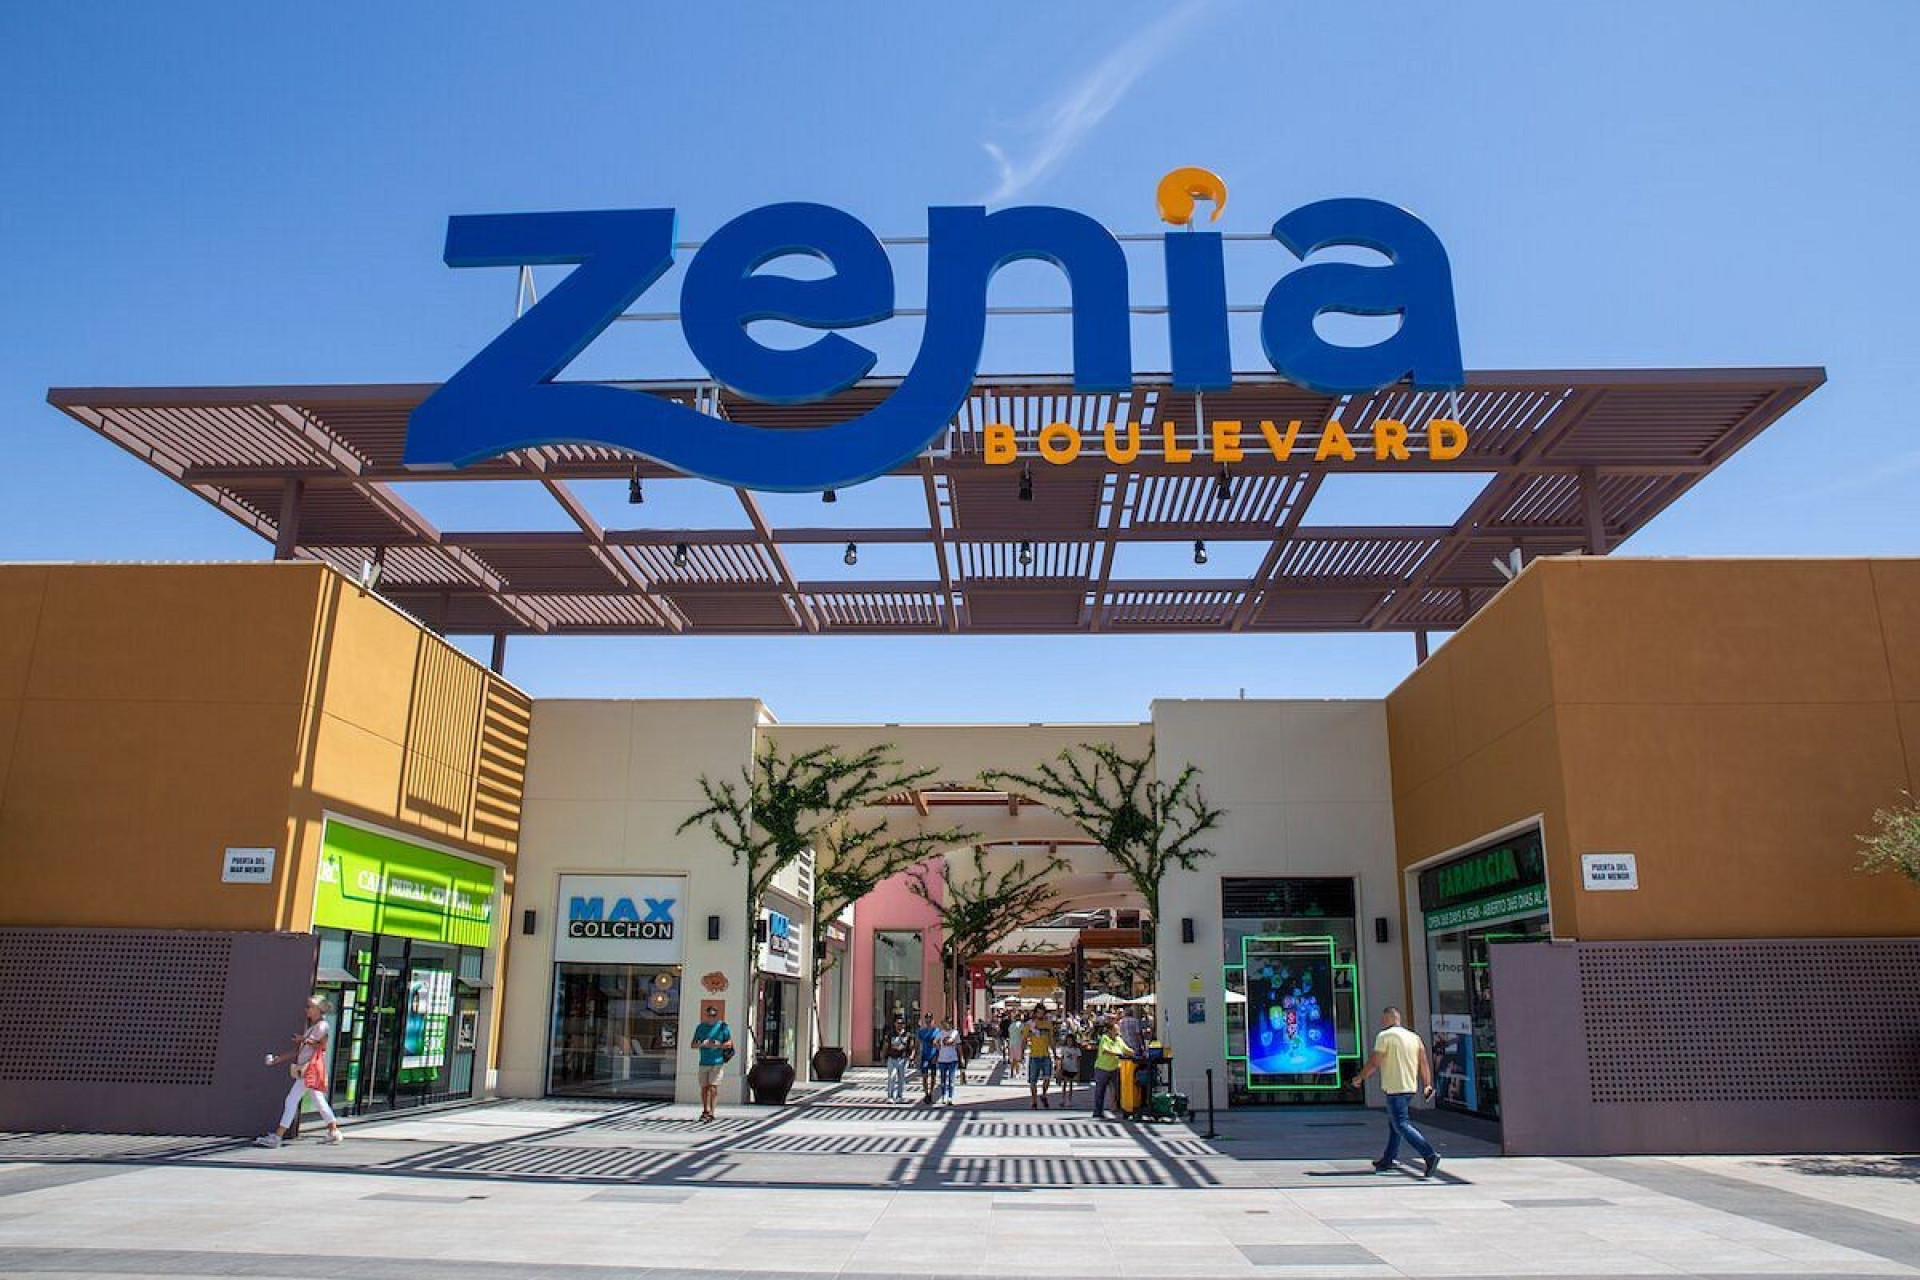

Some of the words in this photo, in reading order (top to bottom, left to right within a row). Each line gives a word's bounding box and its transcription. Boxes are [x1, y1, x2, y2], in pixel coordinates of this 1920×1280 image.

[983, 419, 1469, 465] BOULEVARD
[1438, 848, 1518, 898] FARMACIA
[1591, 863, 1614, 871] PUERTA
[1607, 872, 1630, 880] MENOR
[570, 896, 676, 922] MAX
[570, 921, 673, 938] COLCHON
